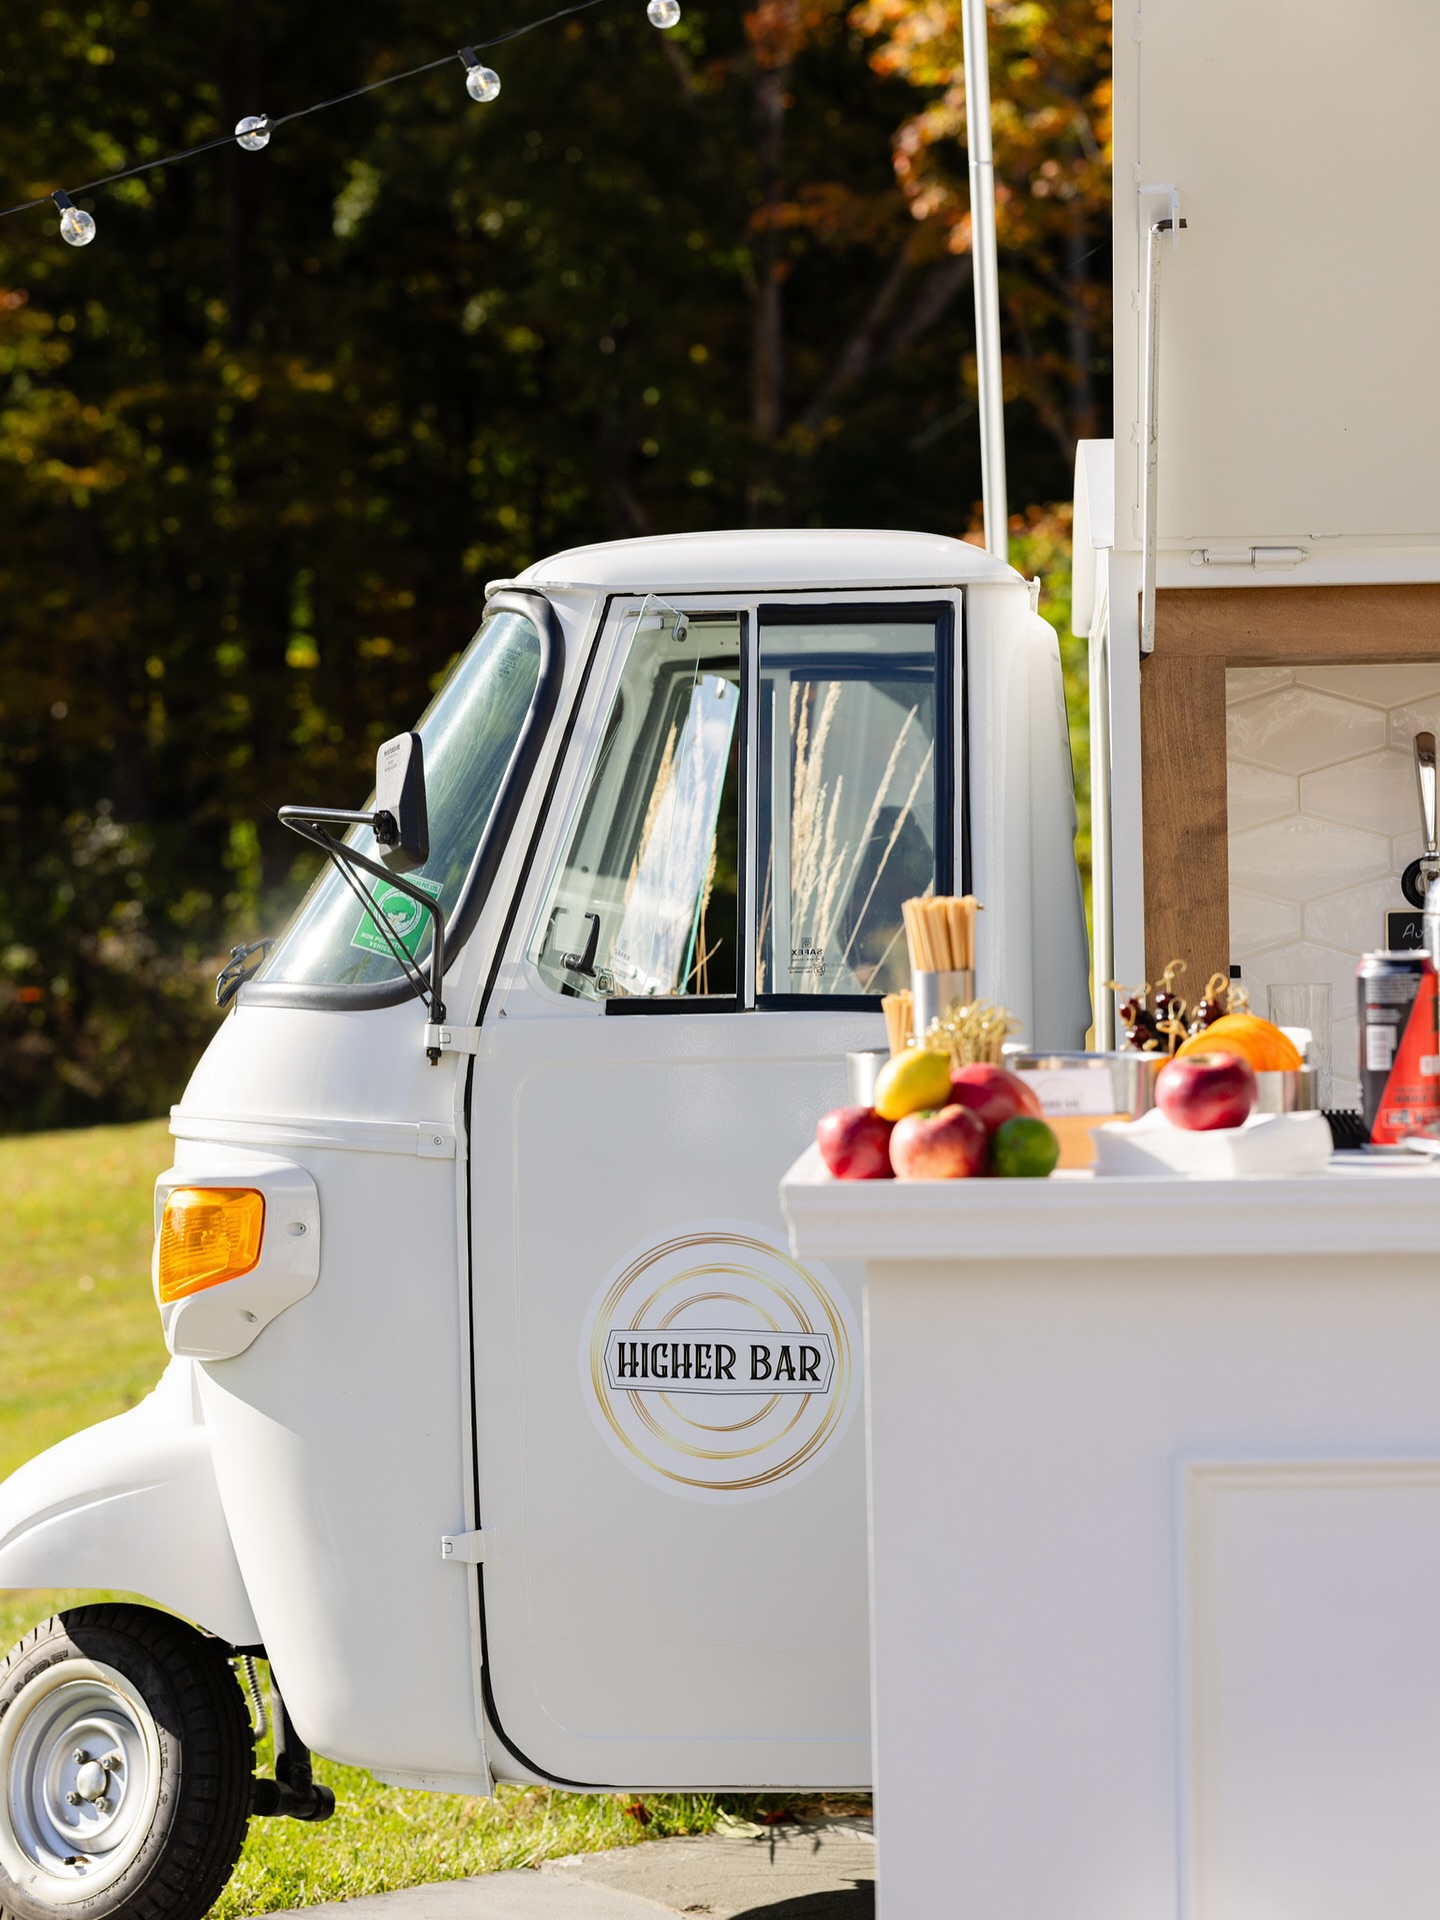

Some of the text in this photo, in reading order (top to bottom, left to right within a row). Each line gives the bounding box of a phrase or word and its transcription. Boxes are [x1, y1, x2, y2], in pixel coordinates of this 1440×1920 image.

[361, 932, 374, 941] NON
[617, 1342, 821, 1381] HIGHER BAR
